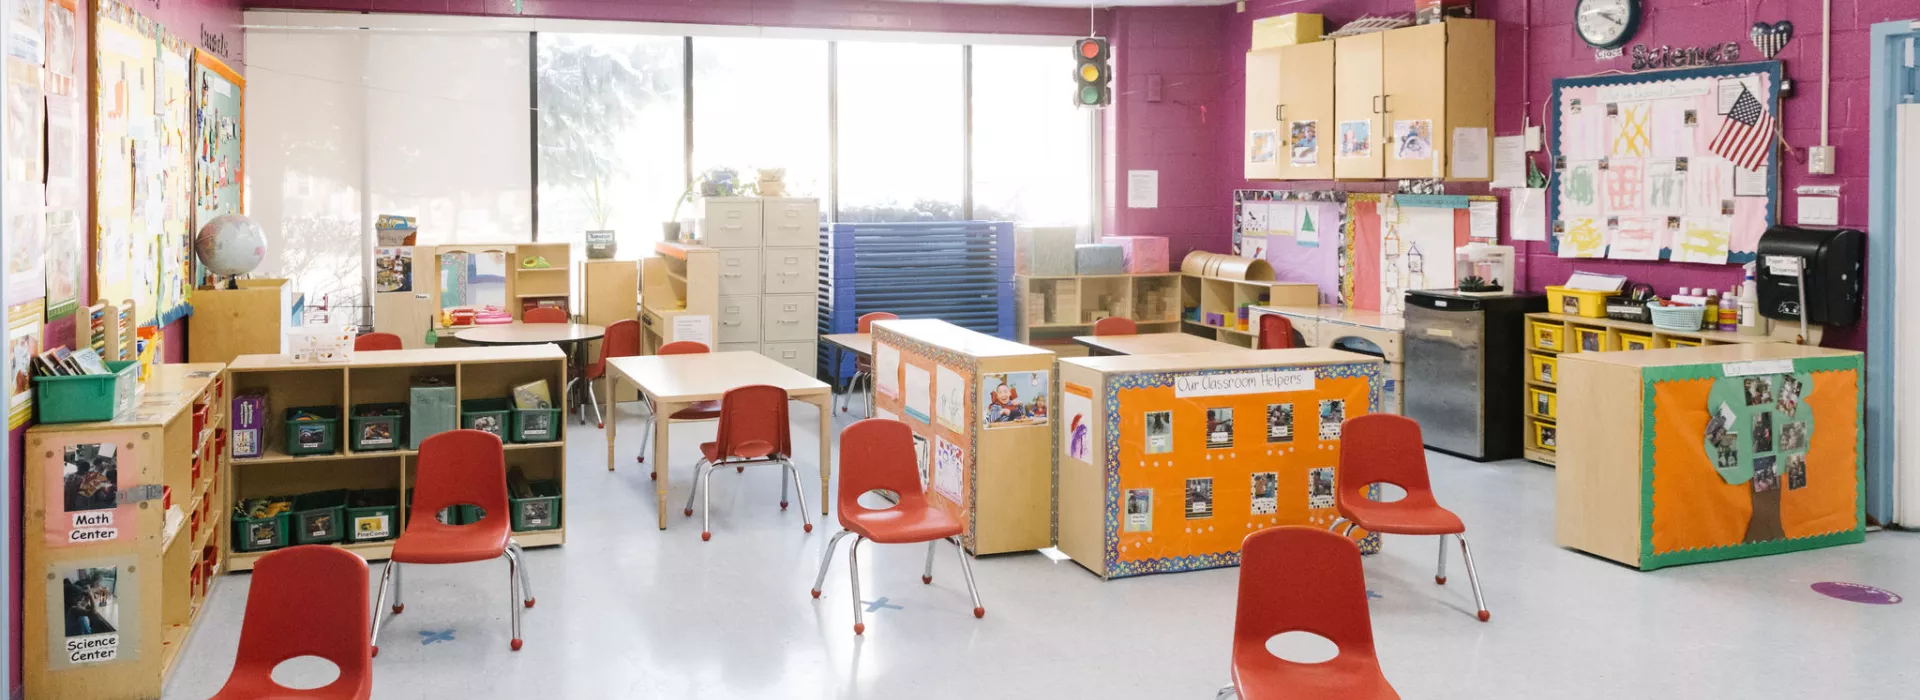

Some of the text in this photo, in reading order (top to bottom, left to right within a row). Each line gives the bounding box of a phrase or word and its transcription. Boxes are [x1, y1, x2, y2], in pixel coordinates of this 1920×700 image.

[1631, 41, 1741, 71] Science
[1177, 373, 1303, 392] Our Classroom Helpers
[75, 513, 109, 525] Math
[71, 530, 115, 540] Center
[67, 637, 116, 651] Science
[71, 650, 115, 662] Center
